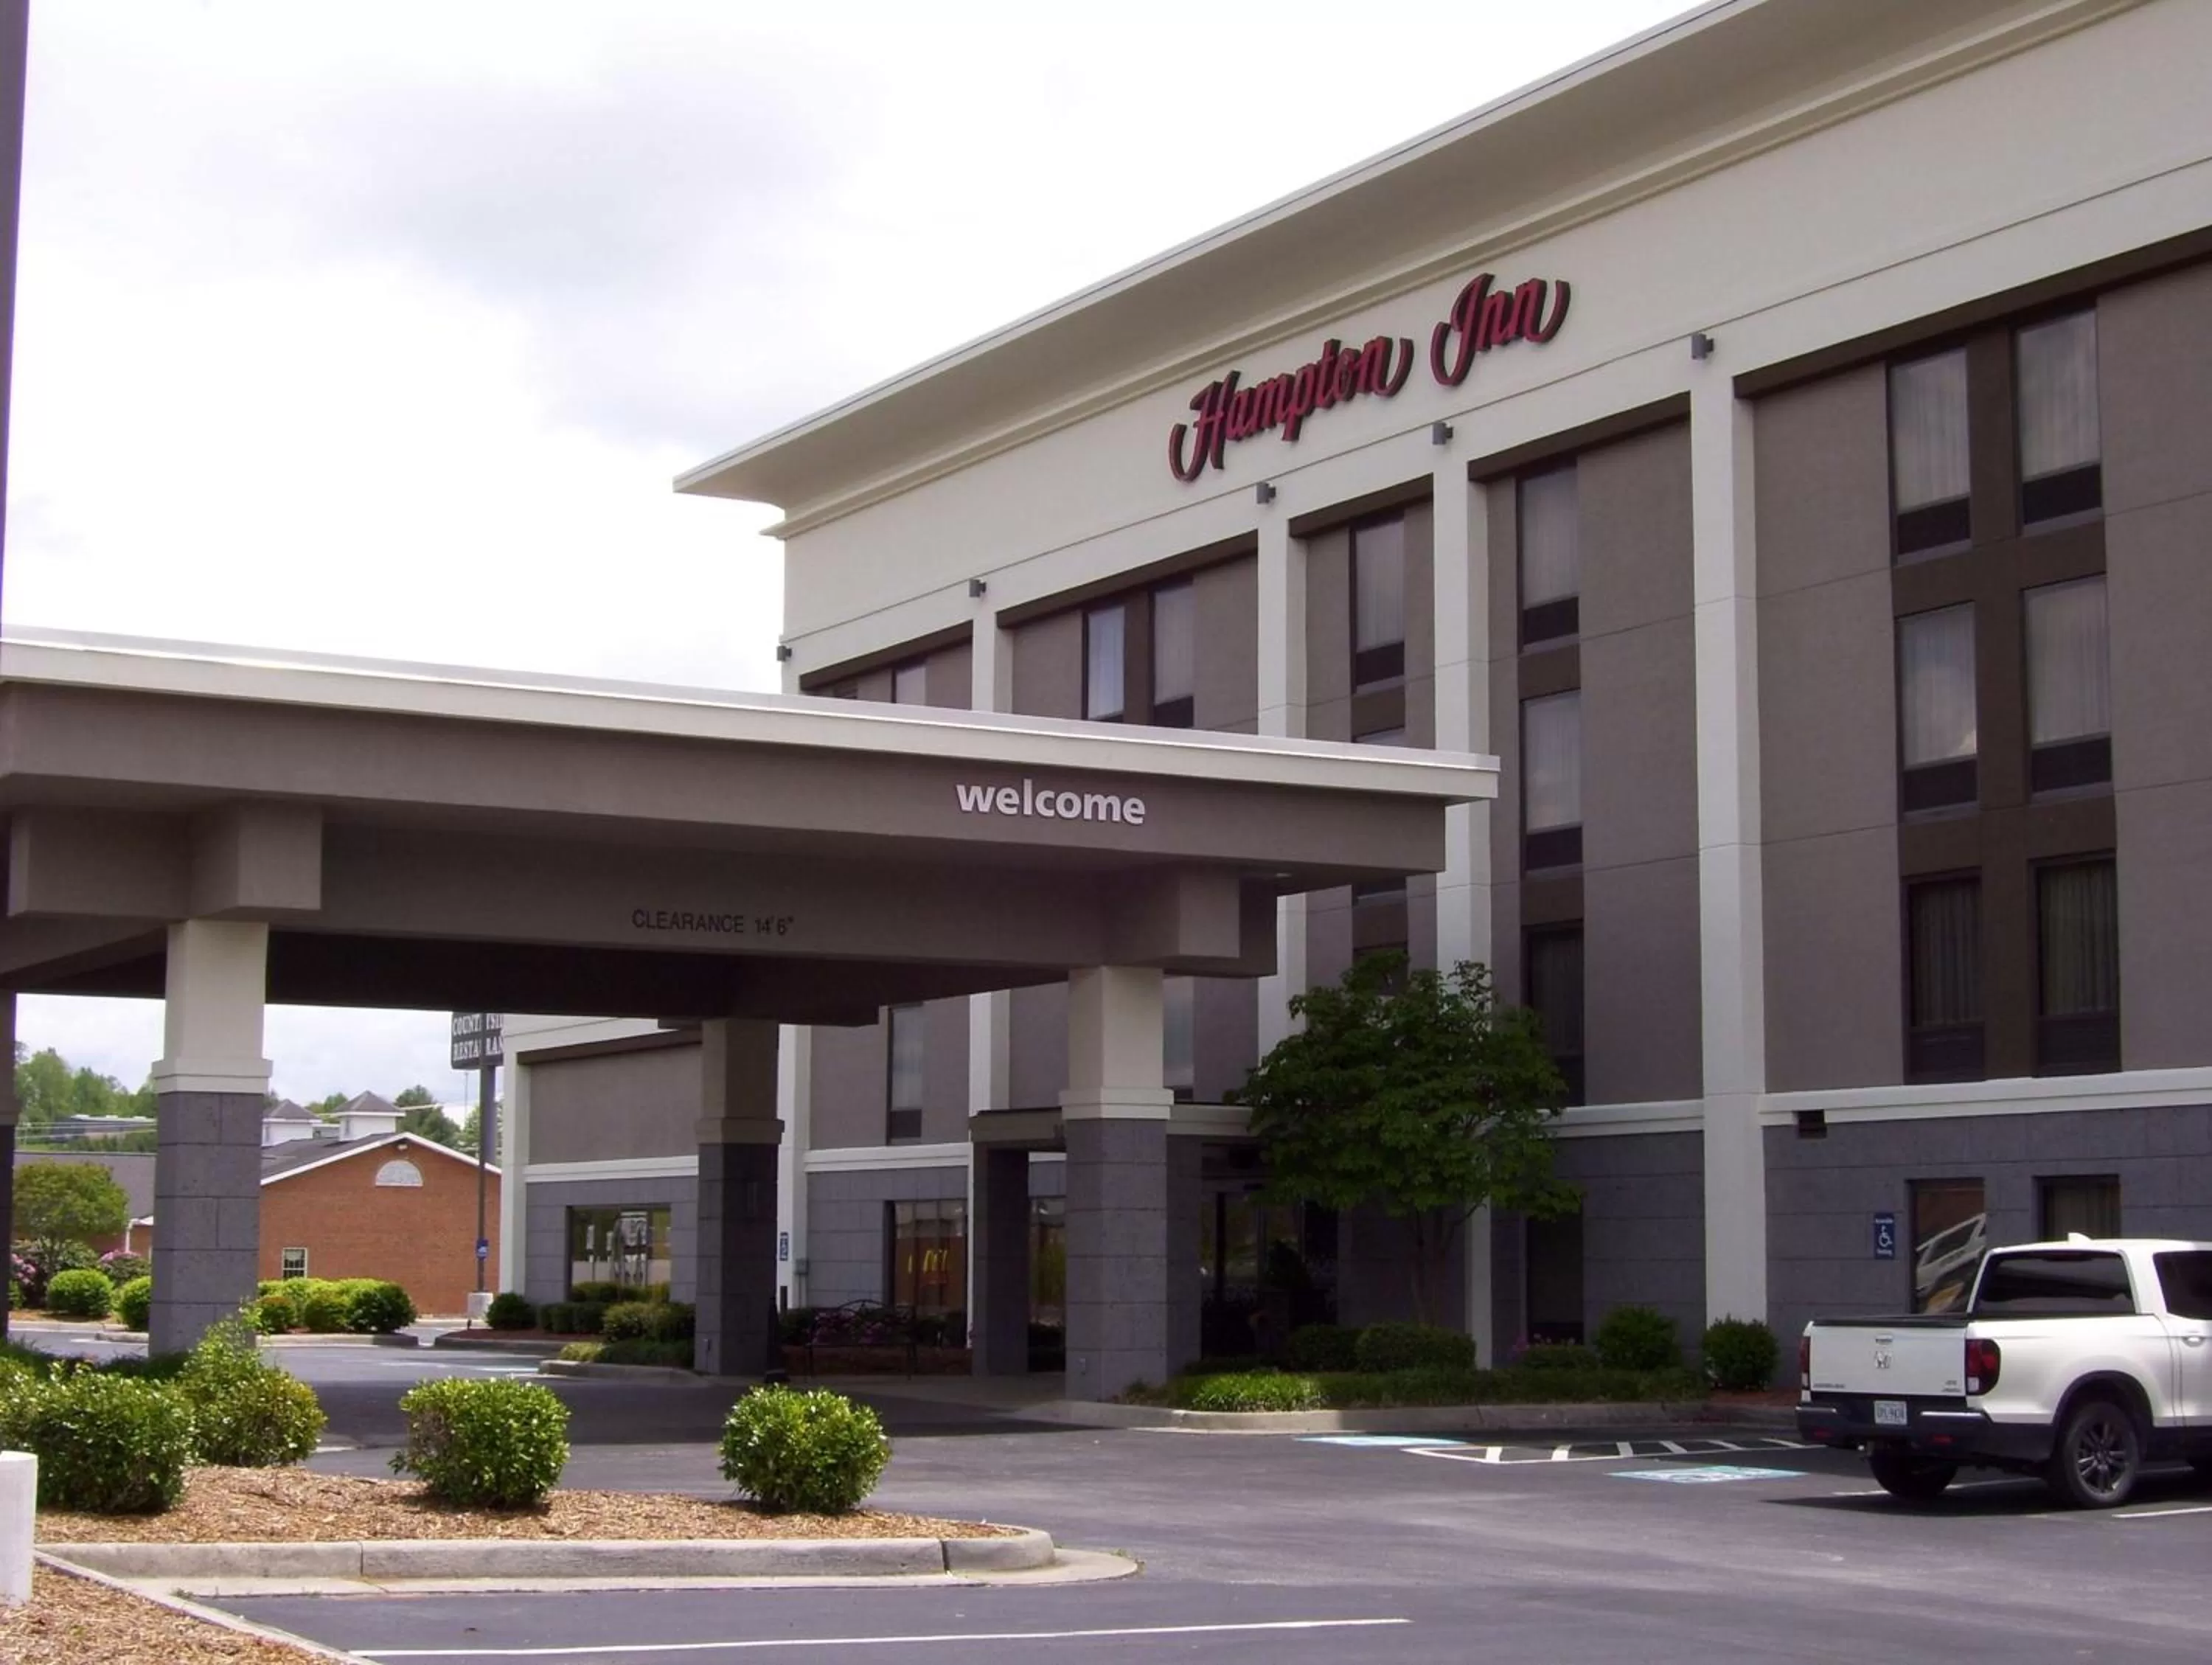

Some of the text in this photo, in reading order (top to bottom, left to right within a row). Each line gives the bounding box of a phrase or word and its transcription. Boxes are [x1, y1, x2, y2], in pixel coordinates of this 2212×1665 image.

[1169, 272, 1571, 483] Hampton Inn
[956, 778, 1146, 825] welcome
[631, 908, 744, 934] CLEARANCE
